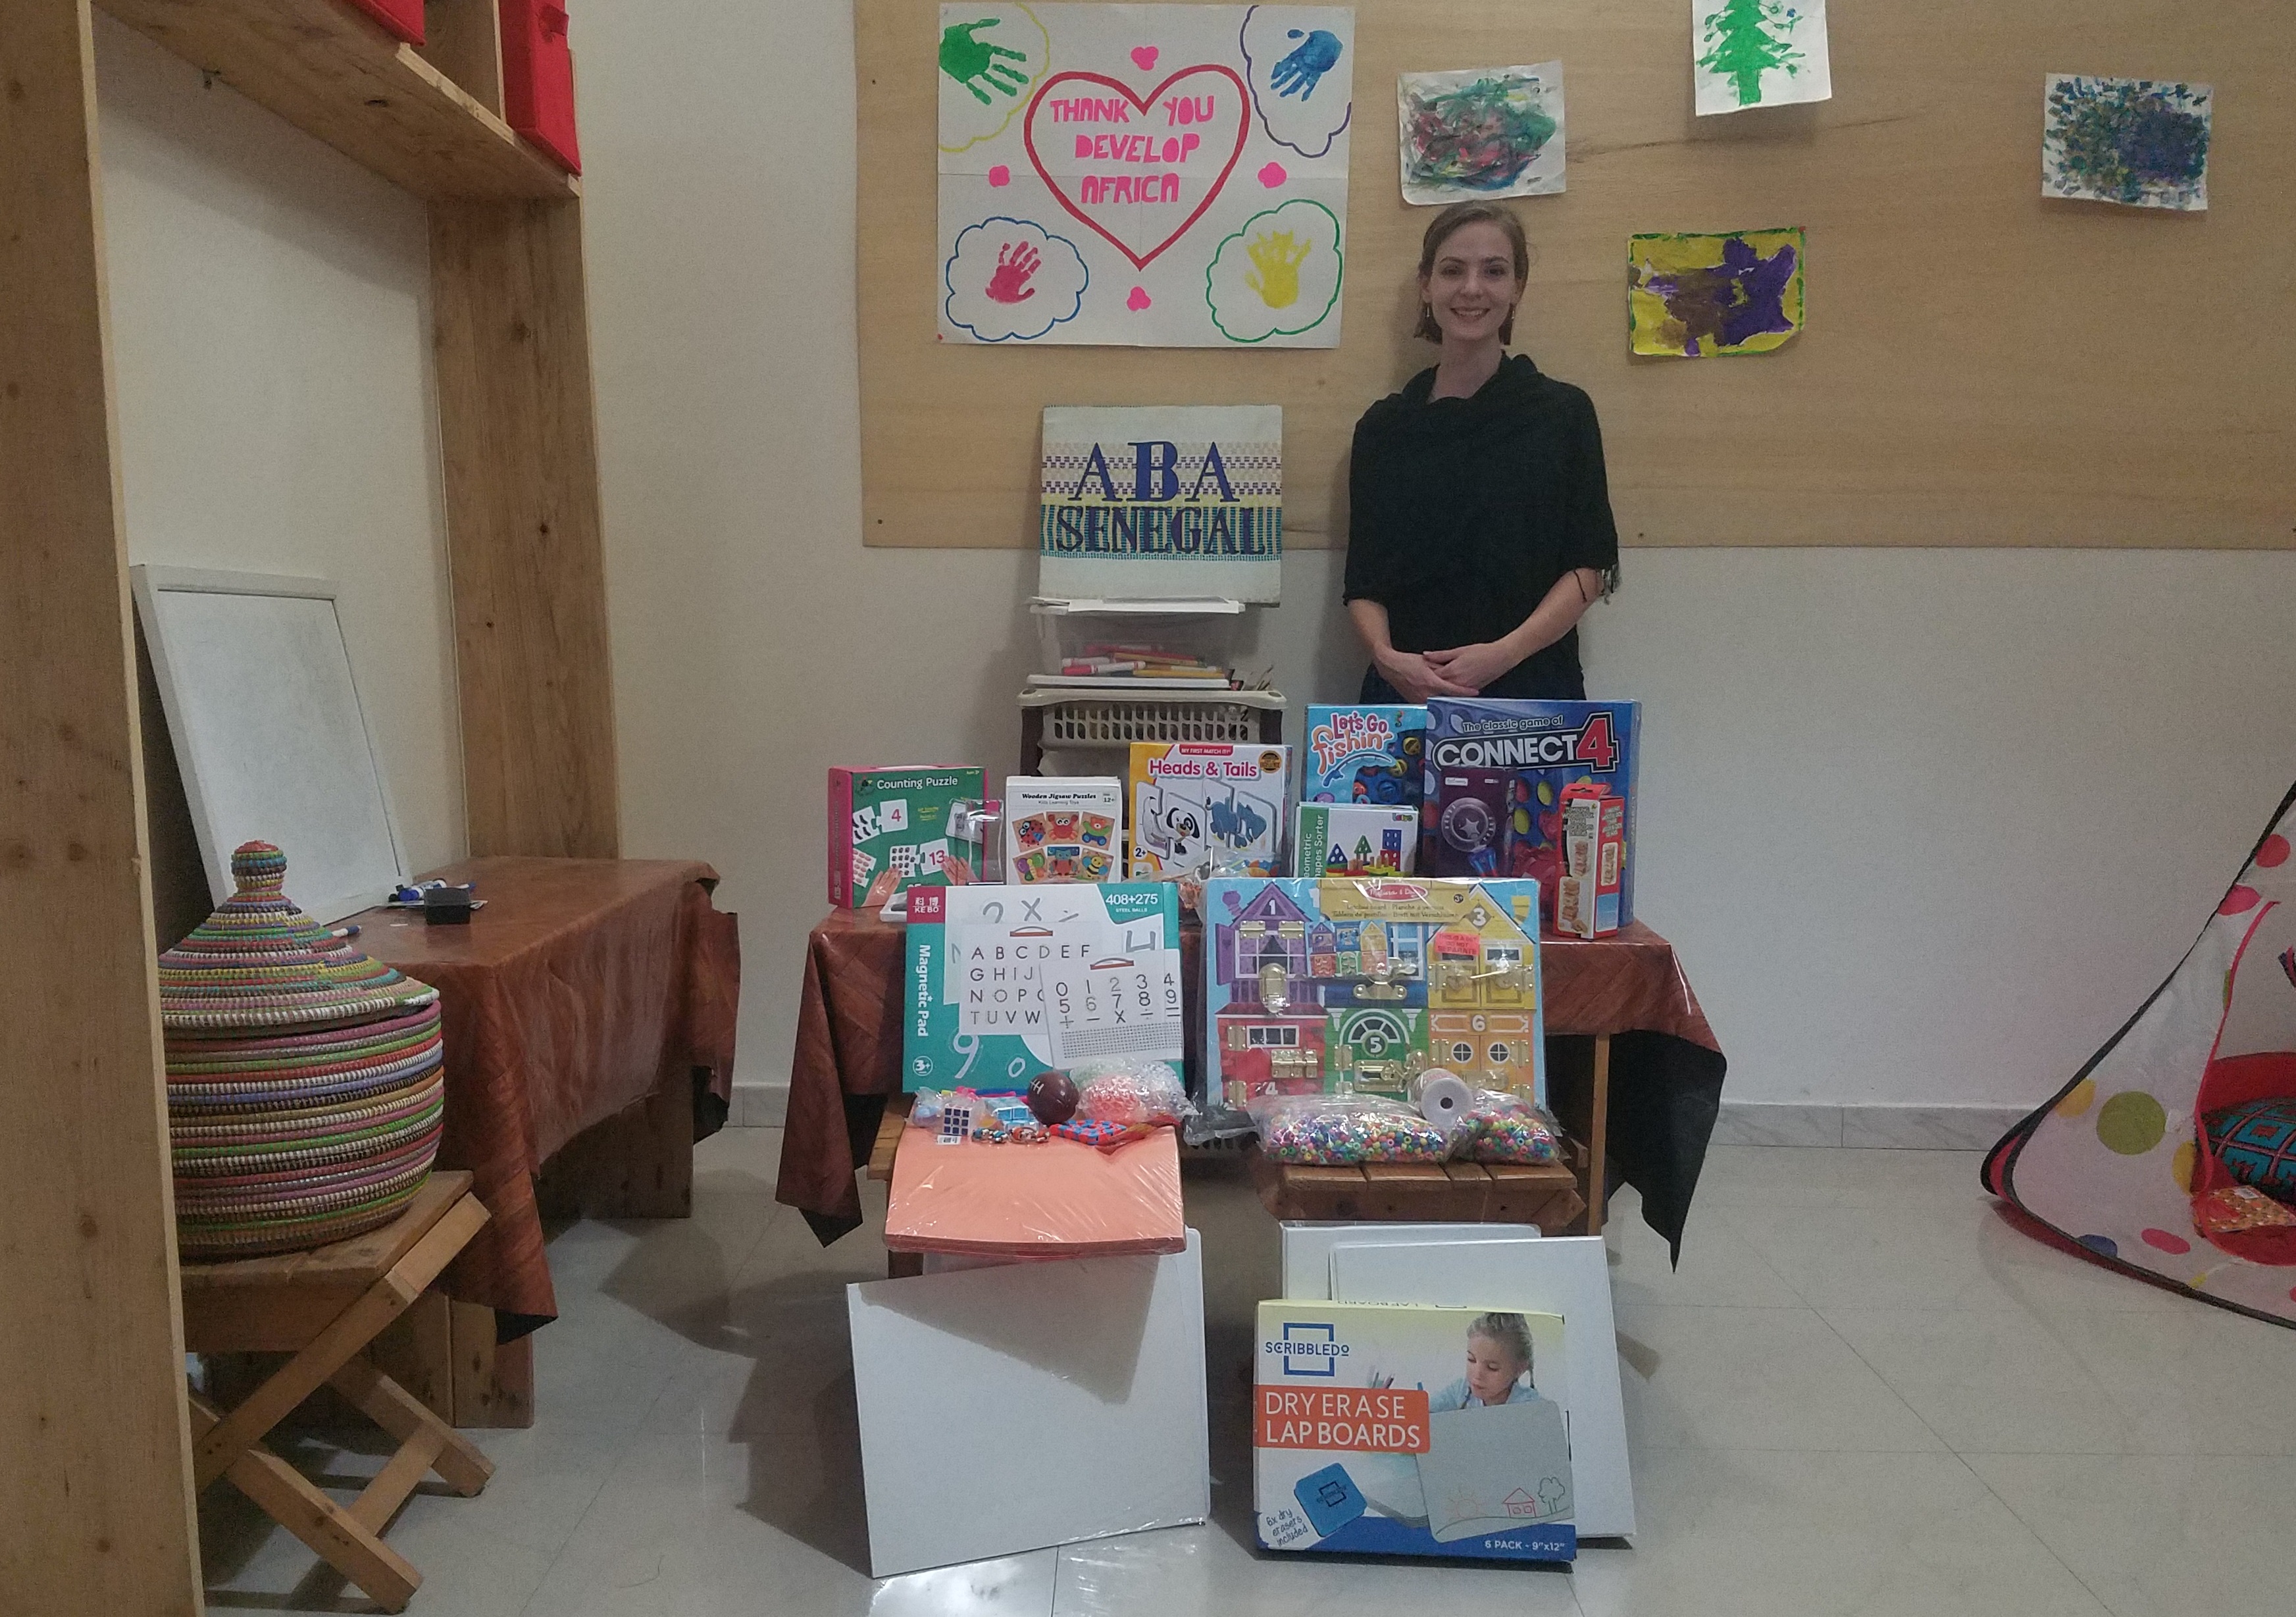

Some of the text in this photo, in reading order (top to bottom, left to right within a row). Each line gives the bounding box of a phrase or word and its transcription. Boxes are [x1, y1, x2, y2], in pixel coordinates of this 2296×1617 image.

[1050, 95, 1214, 126] THANK YOU
[1075, 133, 1200, 163] DEVELOP
[1081, 172, 1179, 204] AFRICA
[1067, 441, 1240, 502] ABA
[1056, 505, 1265, 555] SENEGAL
[1331, 712, 1388, 739] Let's Go
[1463, 715, 1563, 732] The classic game of
[1437, 718, 1614, 767] CONNECT 4
[1150, 760, 1258, 777] Heads & Tails
[877, 776, 958, 790] Counting Puzzle
[892, 809, 902, 822] 4
[1135, 847, 1146, 858] 2+
[1314, 815, 1324, 877] apes Sorter
[929, 850, 945, 865] 13
[1106, 893, 1158, 906] 408+275
[1269, 899, 1276, 915] 1
[1473, 908, 1486, 926] 3
[971, 946, 984, 960] A
[995, 946, 1005, 960] B
[1015, 946, 1028, 960] C
[1039, 945, 1050, 959] D
[1061, 944, 1070, 958] E
[1081, 944, 1090, 958] F
[970, 966, 1033, 981] G H I J
[915, 944, 933, 1037] Magnetic Pad
[1056, 982, 1068, 996] 0
[1086, 979, 1091, 994] 1
[1110, 977, 1121, 992] 2
[1136, 974, 1148, 989] 3
[1163, 973, 1175, 986] 4
[970, 989, 983, 1003] N
[994, 988, 1008, 1003] O
[1018, 988, 1027, 1002] P
[1059, 989, 1177, 1014] 5 6 7 8 9
[971, 1010, 1040, 1025] T U V W
[1472, 1015, 1486, 1032] 6
[1370, 1037, 1382, 1053] 5
[954, 1031, 979, 1079] 9
[1265, 1082, 1278, 1095] 4
[1266, 1392, 1406, 1420] DRY ERASE
[1266, 1420, 1420, 1448] LAP BOARDS
[1279, 1508, 1293, 1521] dry
[1273, 1516, 1302, 1537] erasers
[1277, 1524, 1309, 1547] included
[1485, 1540, 1492, 1549] 6
[1494, 1540, 1522, 1550] PACK
